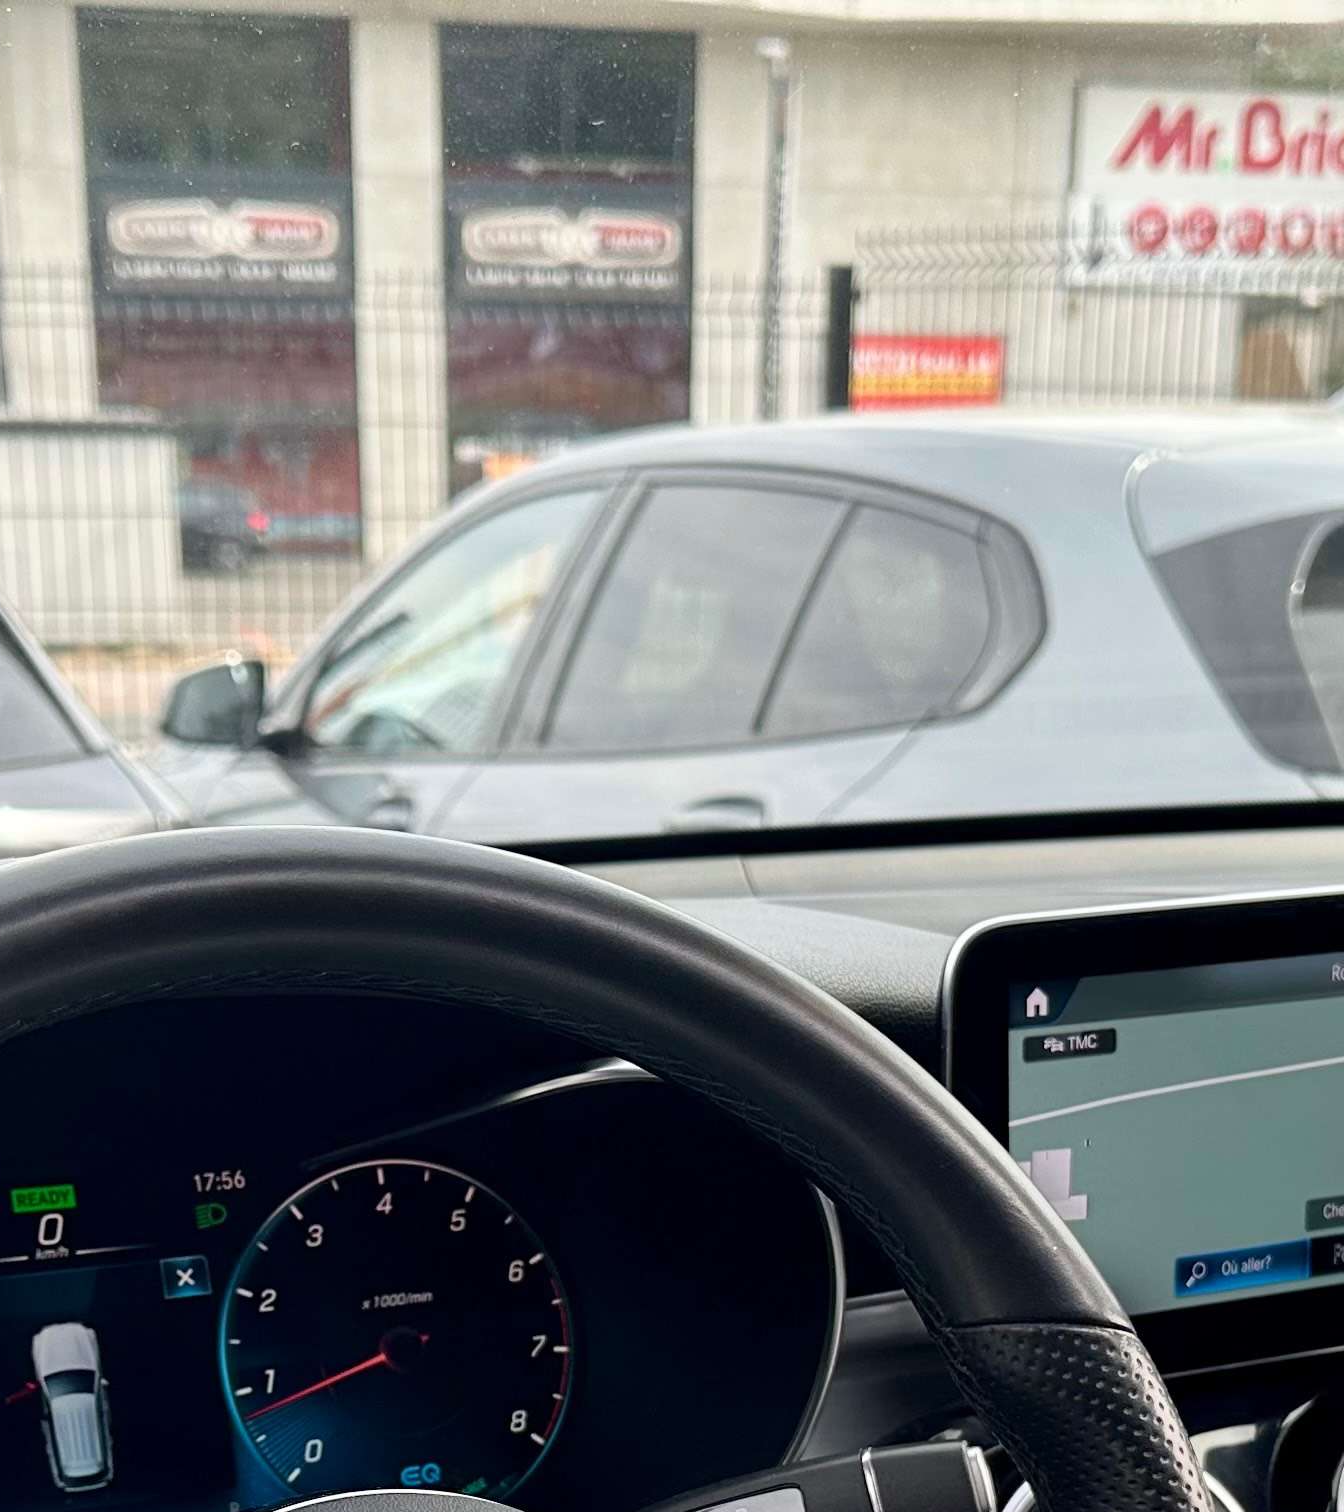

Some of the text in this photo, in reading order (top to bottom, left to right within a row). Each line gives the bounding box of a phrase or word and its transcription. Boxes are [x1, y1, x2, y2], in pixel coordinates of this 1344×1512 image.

[1067, 1034, 1098, 1052] TMC
[193, 1170, 246, 1193] 17:56
[15, 1189, 70, 1209] READY
[375, 1192, 393, 1215] 4
[38, 1213, 64, 1246] 0
[450, 1209, 467, 1232] 5
[306, 1225, 324, 1248] 3
[508, 1259, 525, 1283] 6
[1221, 1254, 1273, 1277] Où aller?
[259, 1290, 278, 1313] 2
[531, 1335, 547, 1358] 7
[264, 1369, 277, 1394] 1
[510, 1409, 528, 1433] 8
[304, 1438, 324, 1464] 0
[400, 1463, 442, 1487] EQ
